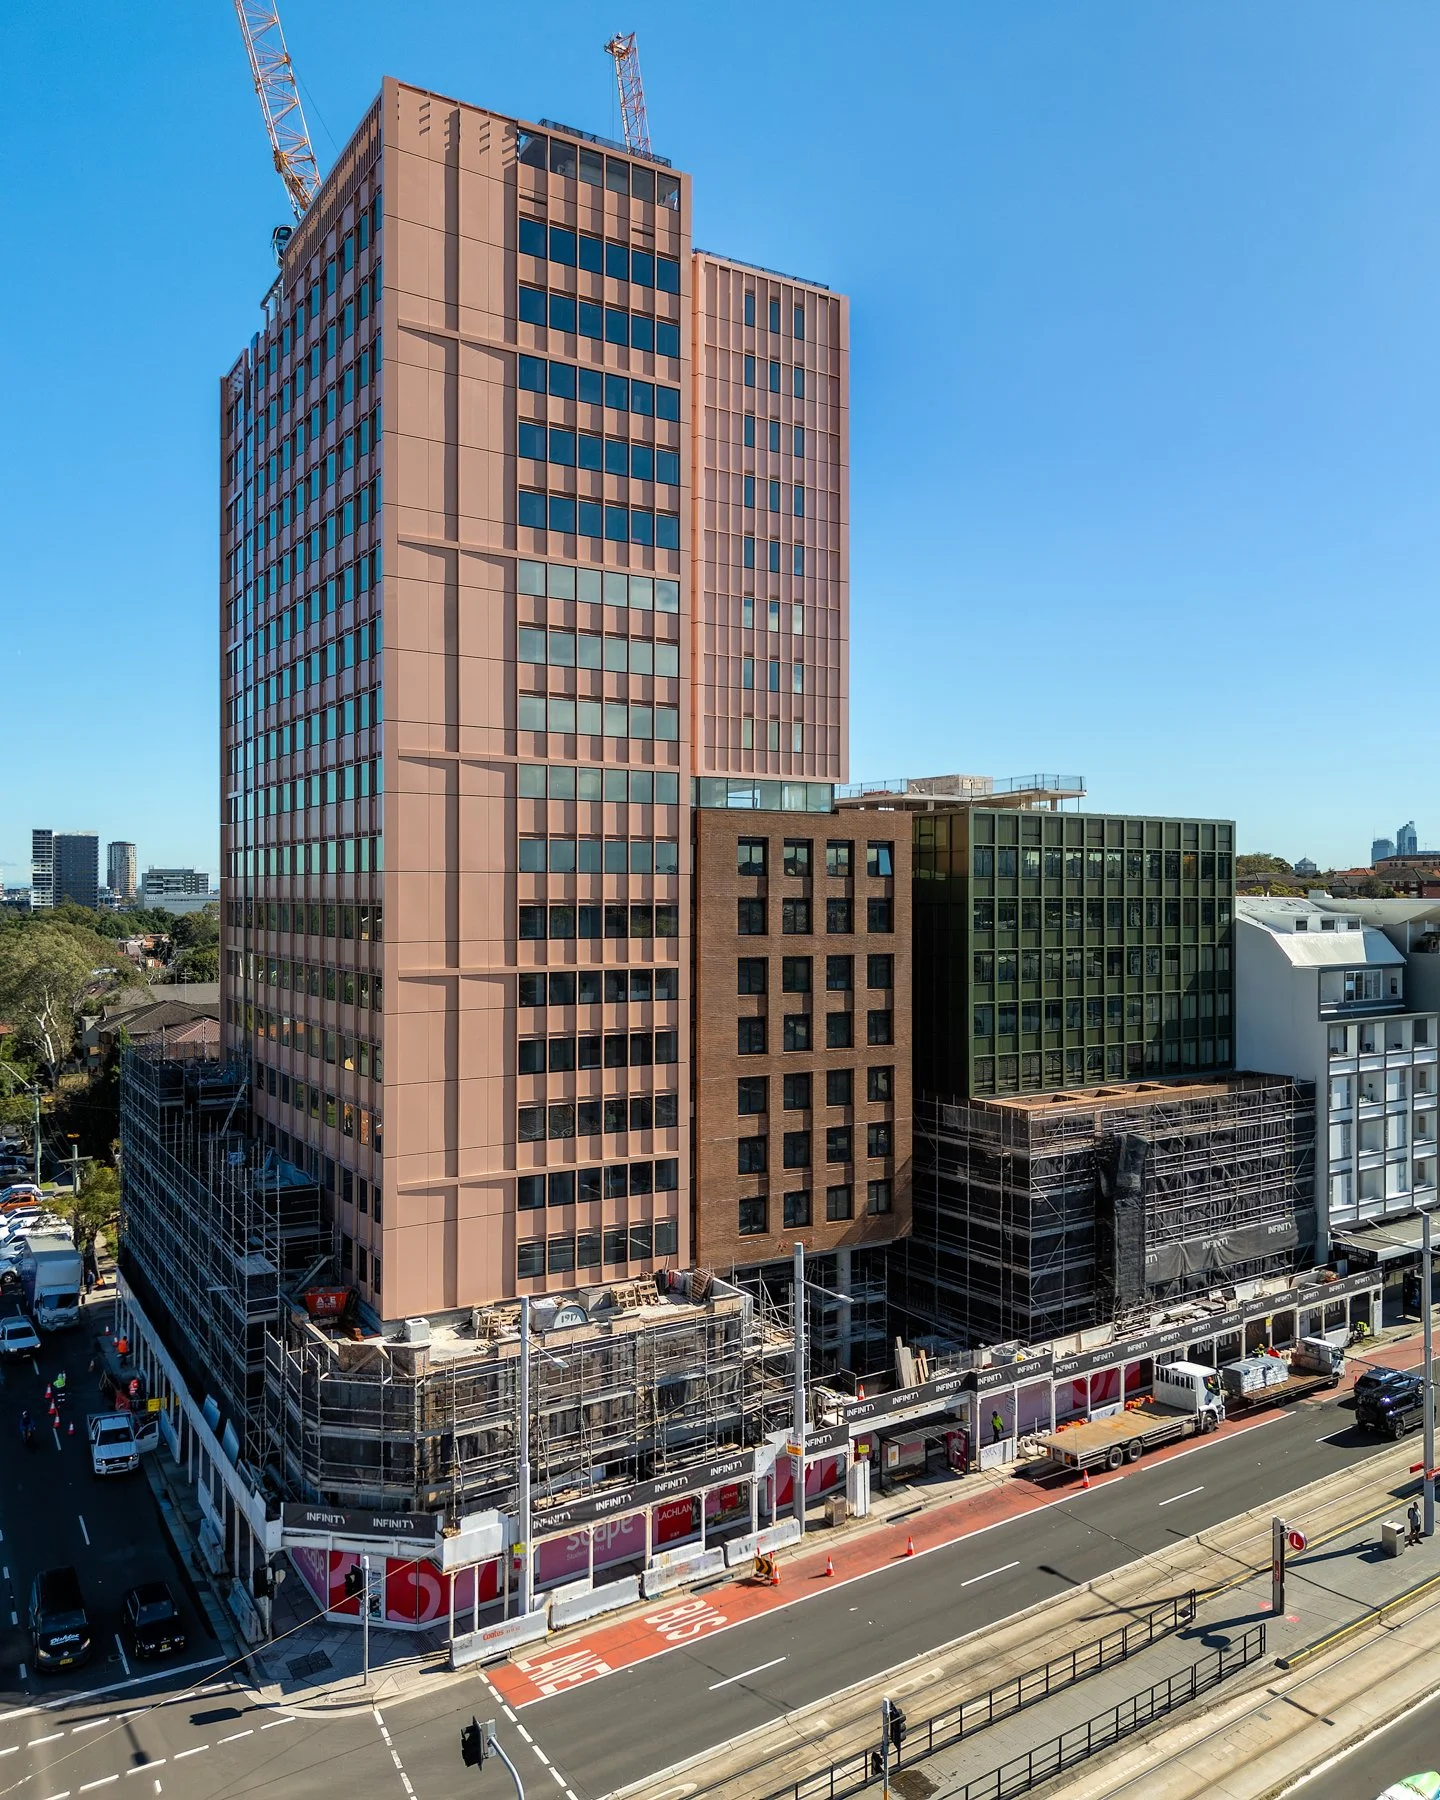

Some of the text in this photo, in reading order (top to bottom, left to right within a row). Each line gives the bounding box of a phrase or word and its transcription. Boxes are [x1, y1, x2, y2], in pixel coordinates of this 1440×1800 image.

[1268, 1222, 1292, 1234] INFINITY
[1309, 1300, 1346, 1319] INNITY
[561, 1313, 577, 1323] 1917
[1197, 1331, 1239, 1354] INFNITY
[1017, 1362, 1041, 1374] INFINITY
[977, 1373, 1002, 1385] INFINITY
[935, 1380, 962, 1392] INFINITY
[892, 1391, 919, 1404] INFINITY
[846, 1404, 874, 1417] INFINITY
[805, 1434, 832, 1447] NFINITY
[710, 1461, 742, 1476] INFINITY
[654, 1476, 688, 1493] INFINITY
[595, 1494, 632, 1511] INFINITY
[658, 1503, 692, 1520] LACHLAN
[306, 1512, 345, 1525] INFINITY
[373, 1517, 414, 1529] INFINITY
[533, 1510, 571, 1529] INFINITY
[643, 1599, 728, 1641] BUS
[514, 1638, 612, 1695] LANE
